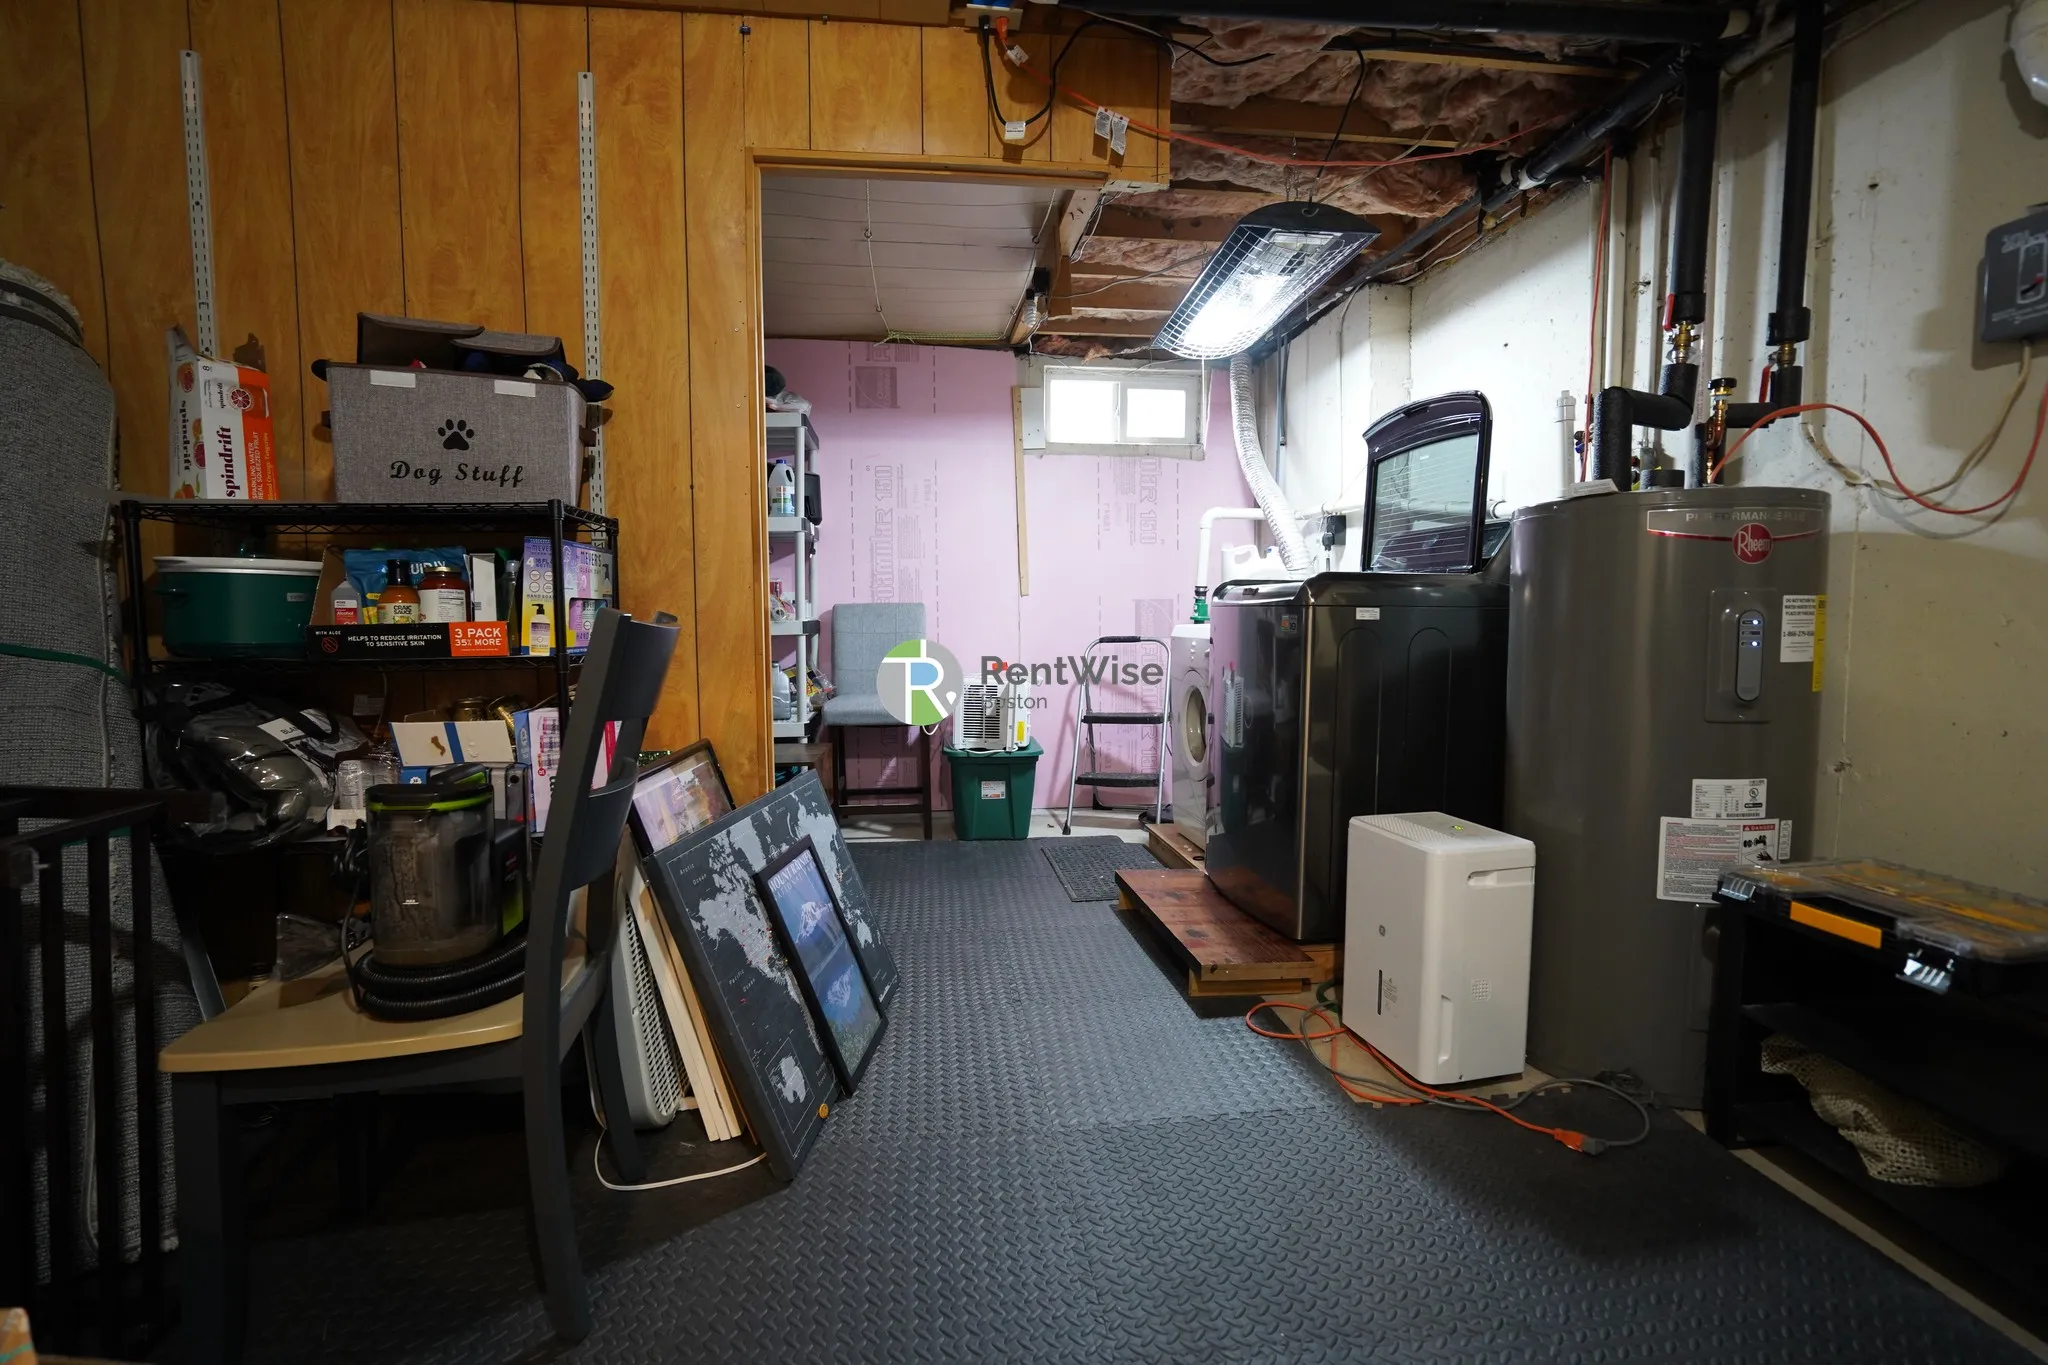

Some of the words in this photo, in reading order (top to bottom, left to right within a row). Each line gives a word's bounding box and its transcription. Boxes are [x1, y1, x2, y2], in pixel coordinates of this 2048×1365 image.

[179, 400, 191, 471] spindrift
[216, 425, 241, 498] spindrift
[254, 450, 263, 483] SQUEEZED
[390, 460, 443, 486] Dog
[455, 462, 524, 488] Stuff
[248, 464, 257, 500] SPARKLING
[256, 483, 264, 500] REAL
[874, 465, 893, 502] 150
[1738, 523, 1771, 558] Rheem
[454, 628, 463, 638] 3
[467, 627, 502, 638] PACK
[474, 638, 503, 646] MORE
